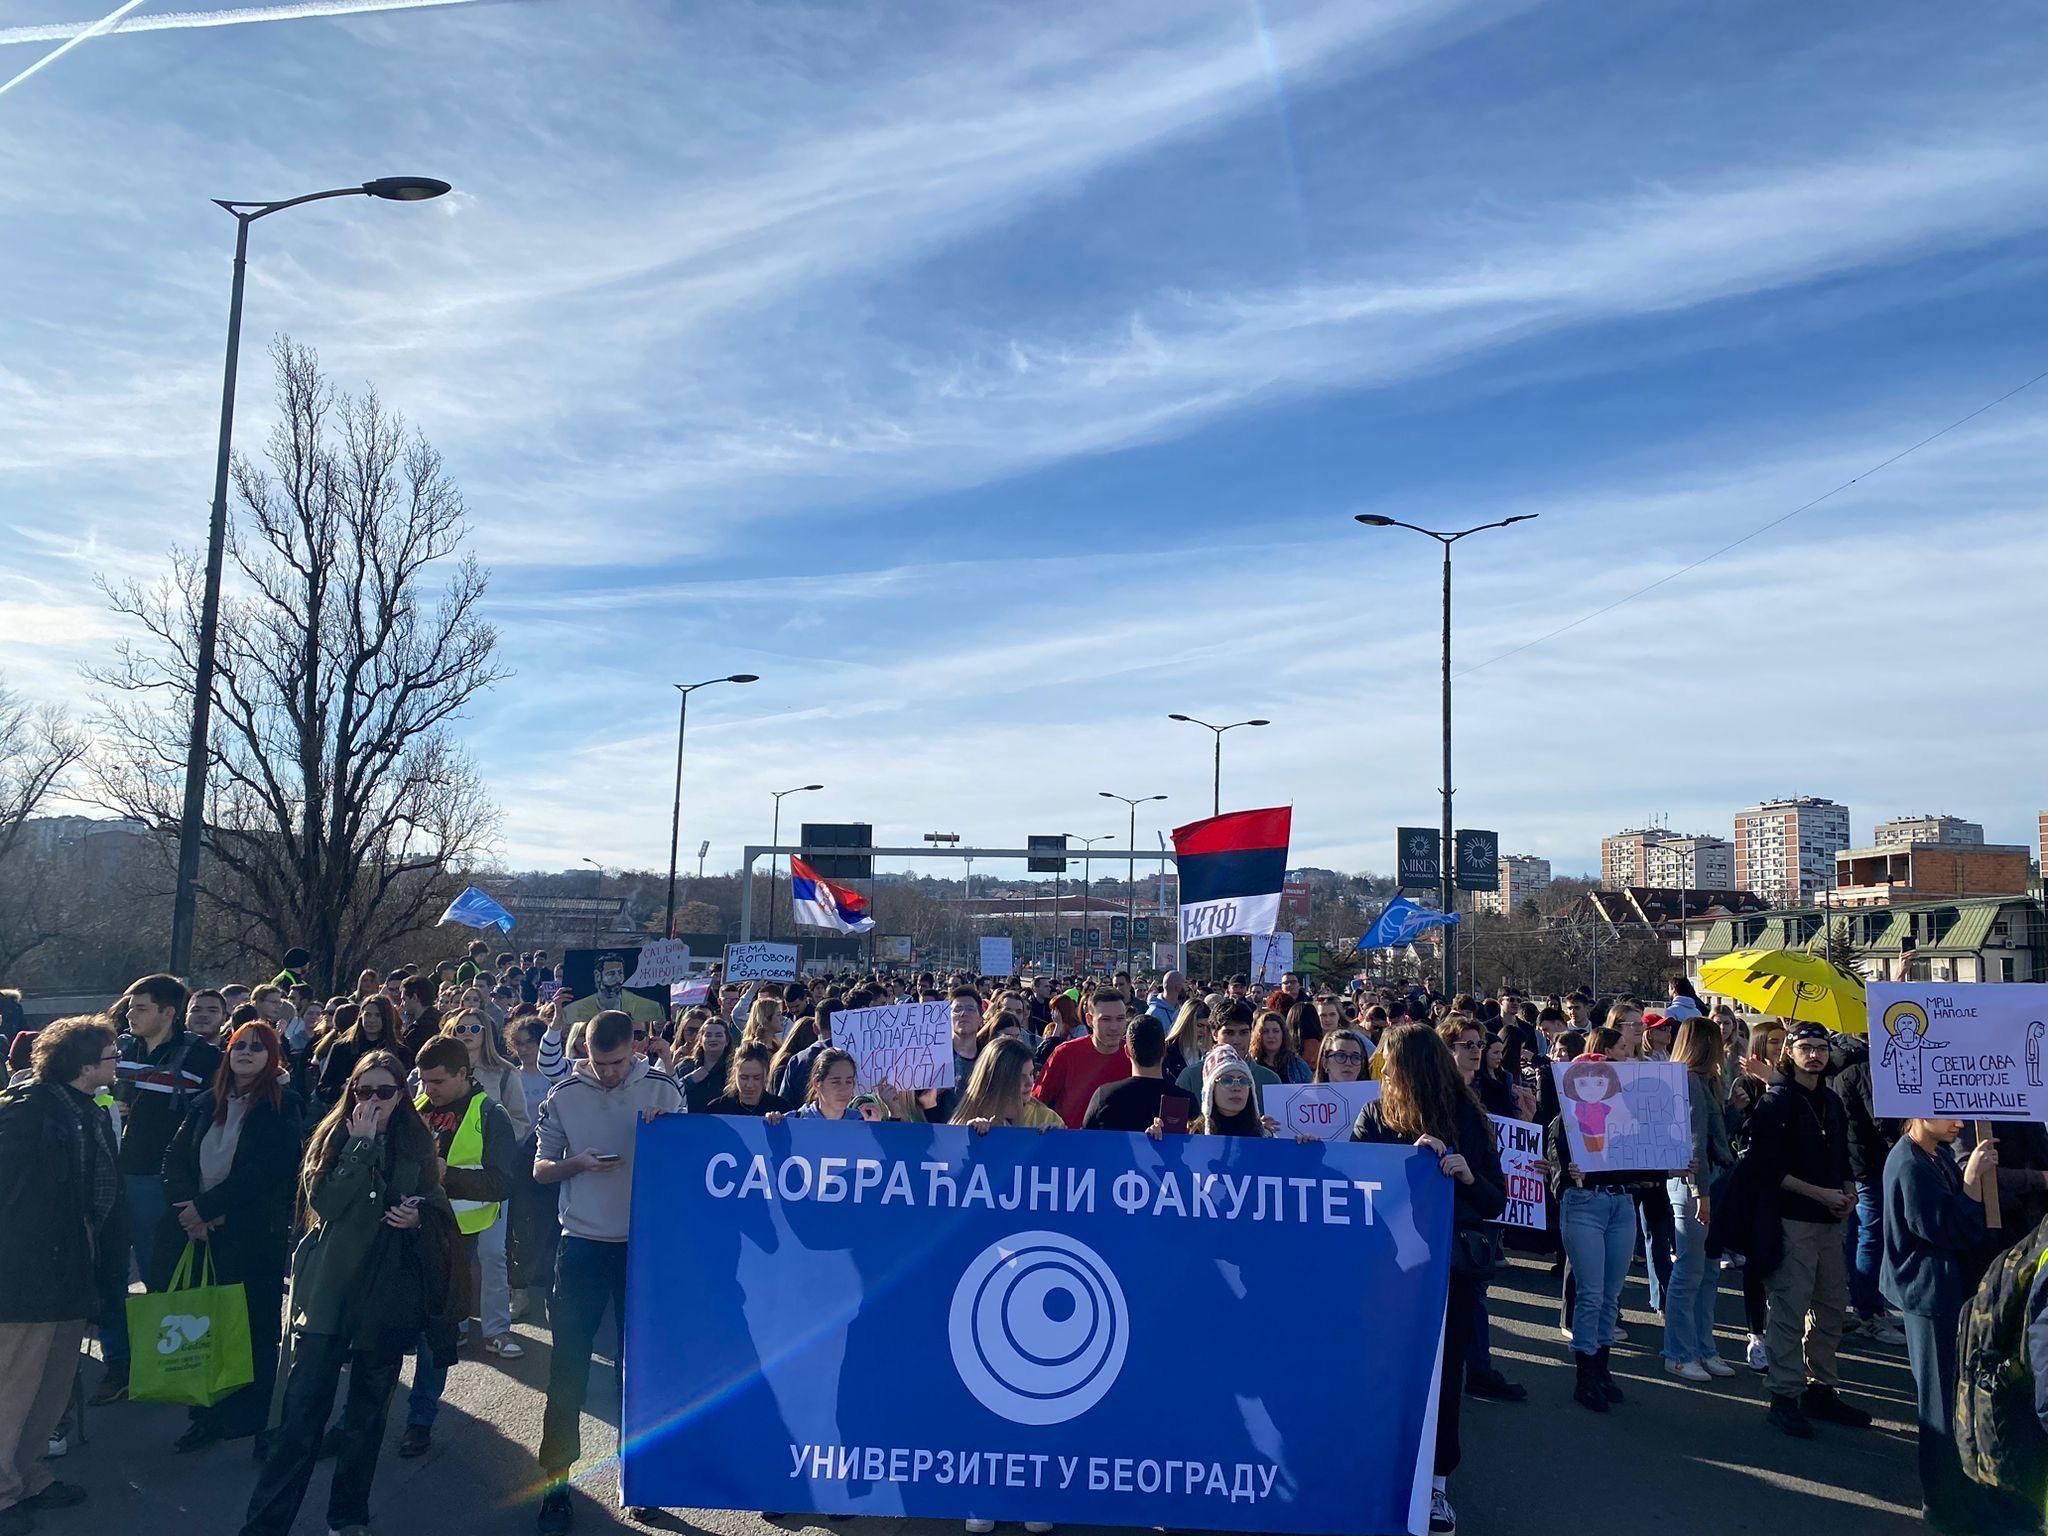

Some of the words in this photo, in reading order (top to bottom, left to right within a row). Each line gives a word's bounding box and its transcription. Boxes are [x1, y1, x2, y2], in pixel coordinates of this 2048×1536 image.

[1401, 858, 1438, 873] MIREN
[730, 944, 767, 957] НЕМА
[736, 953, 796, 964] ДОГОВОРА
[730, 963, 749, 973] БЕЗ
[1926, 997, 1953, 1009] МРШ
[833, 1013, 849, 1036] У
[852, 1007, 900, 1032] ТОКУ
[901, 1006, 918, 1027] ЈЕ
[921, 1004, 951, 1024] РОК
[841, 1032, 857, 1053] ЗА
[862, 1012, 946, 1052] ПОЛАГАЊЕ
[860, 1046, 935, 1070] ИСПИТА
[1931, 1055, 1976, 1073] СВЕТИ
[1979, 1055, 2016, 1071] САВА
[1938, 1073, 2010, 1087] ДЕПОРТУЈЕ
[1933, 1091, 2029, 1110] БАТИНАШЕ
[1299, 1103, 1338, 1124] STOP
[1508, 1124, 1541, 1155] HOW
[704, 1152, 1098, 1214] САОБРАЋАЈНИ
[1111, 1168, 1384, 1227] ФАКУЛТЕТ
[789, 1444, 1049, 1488] УНИВЕРЗИТЕТ
[1058, 1456, 1080, 1490] У
[1088, 1457, 1279, 1504] БЕОГРАДУ
